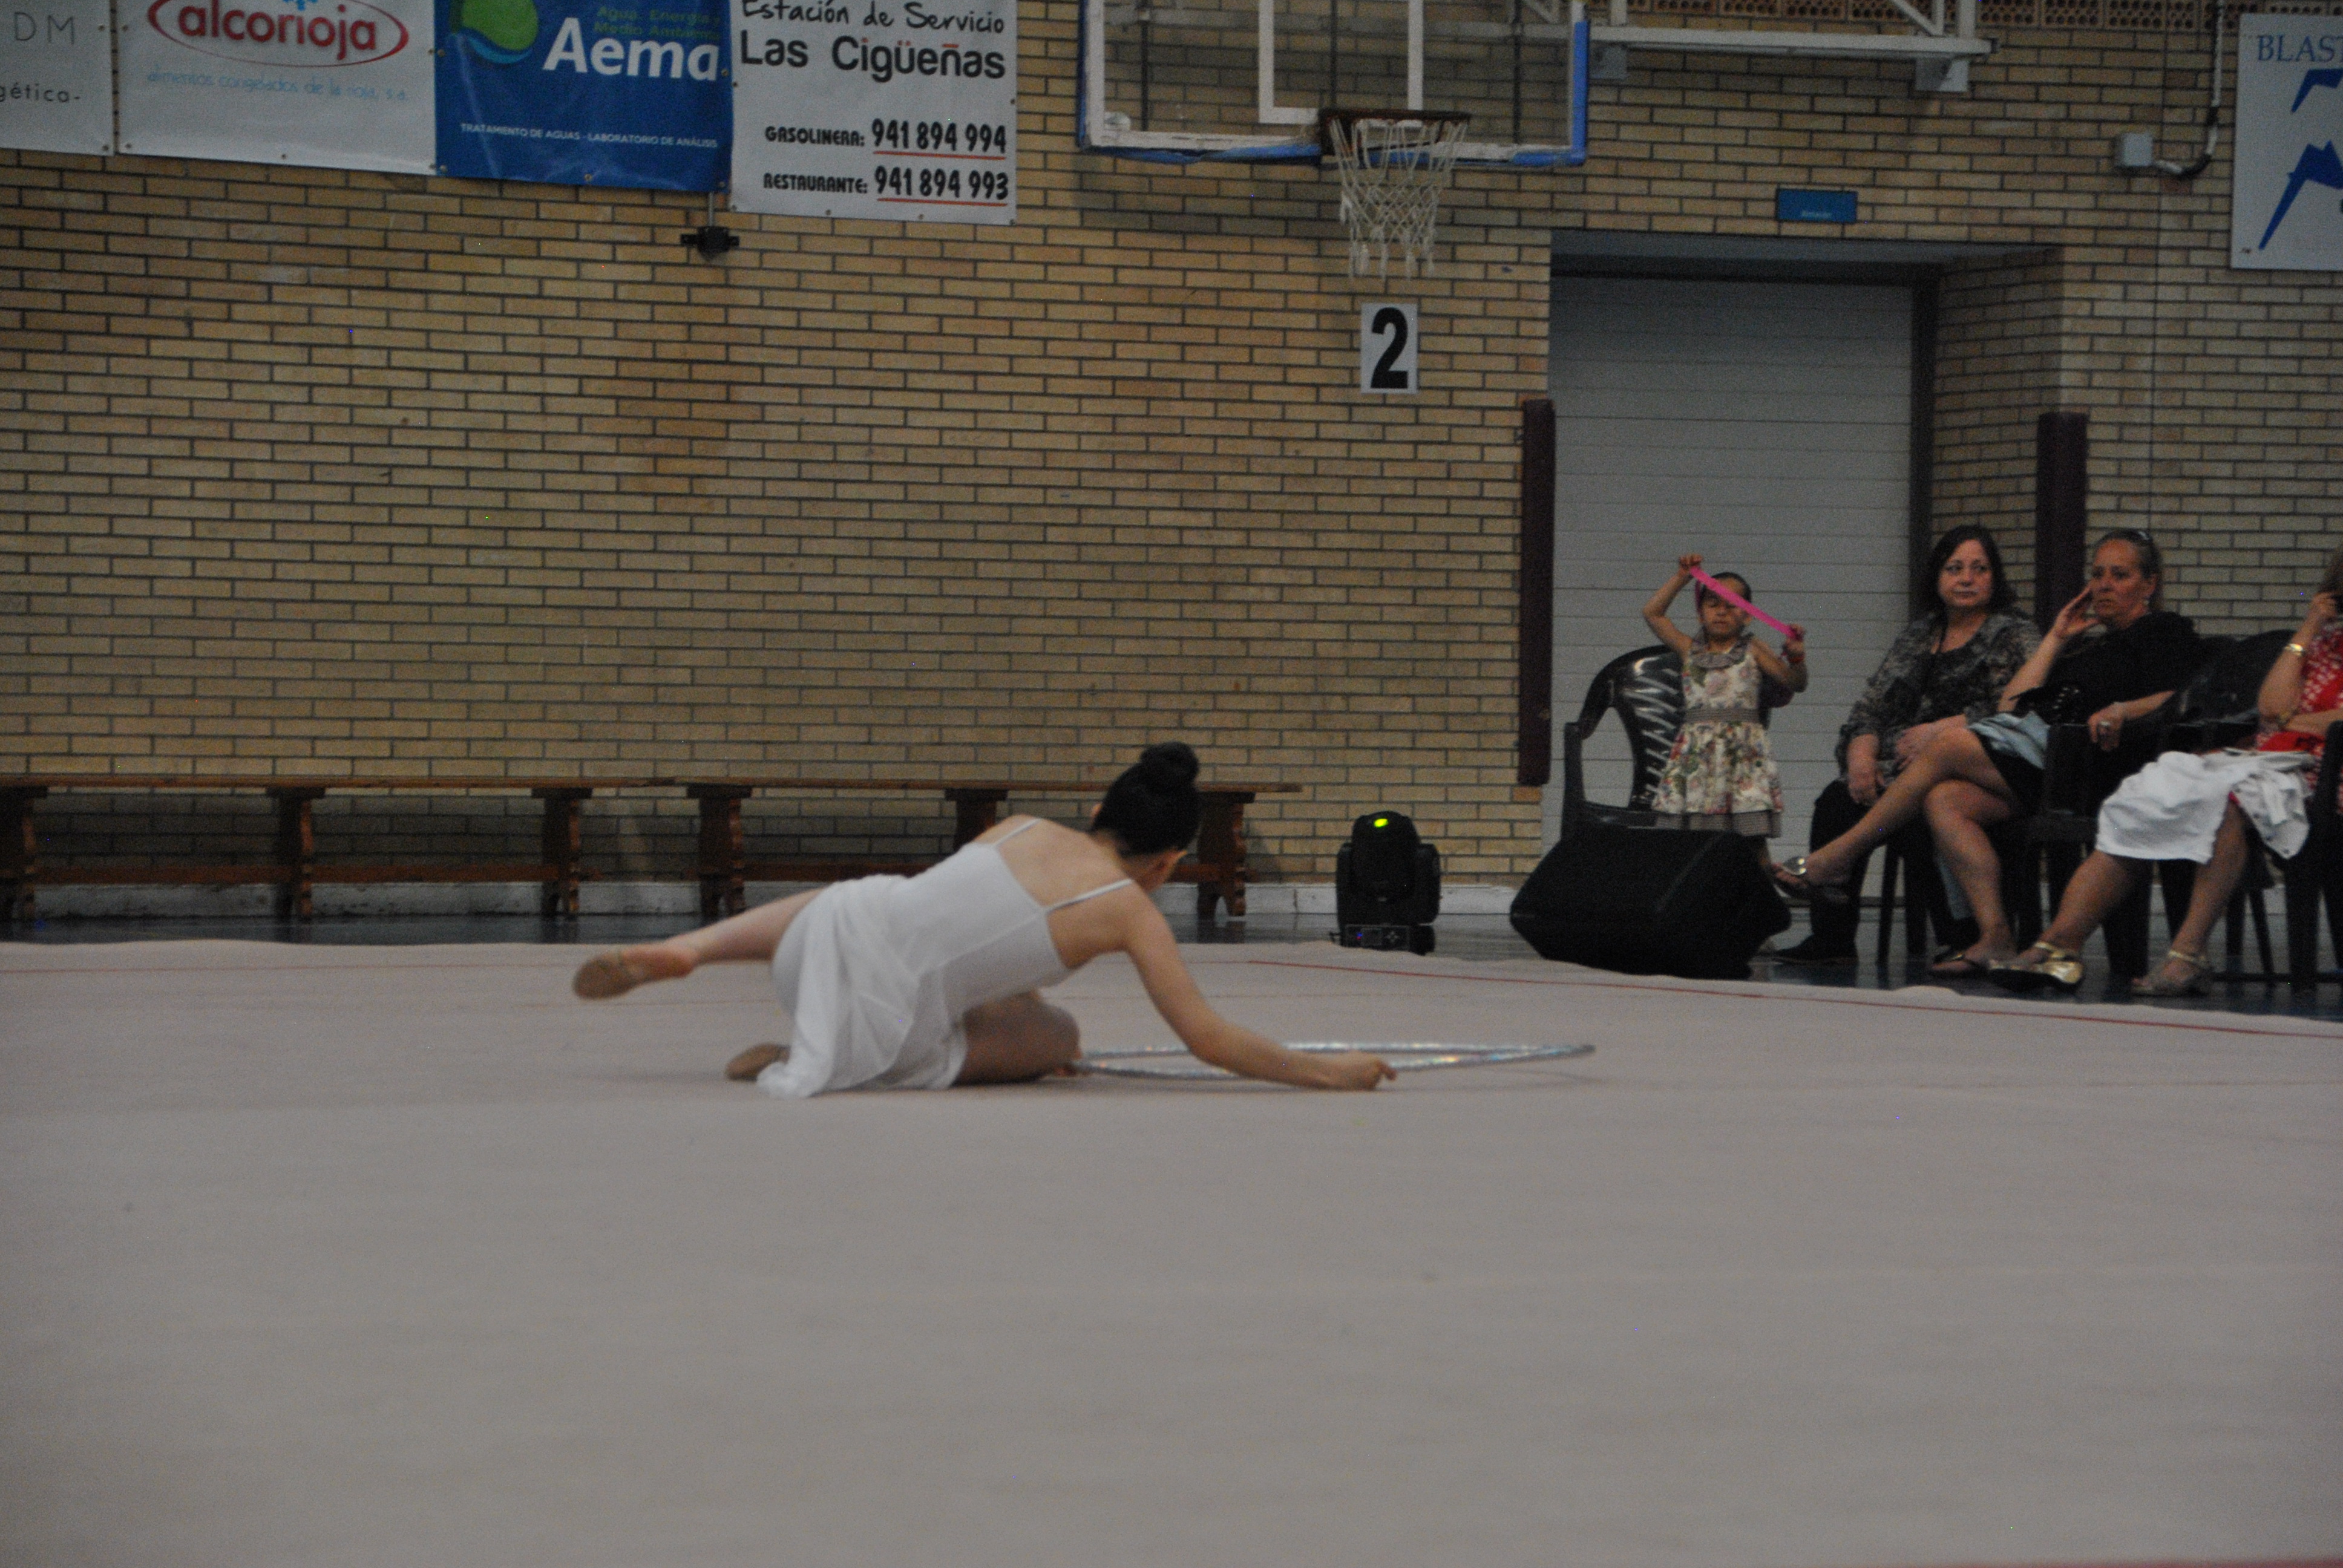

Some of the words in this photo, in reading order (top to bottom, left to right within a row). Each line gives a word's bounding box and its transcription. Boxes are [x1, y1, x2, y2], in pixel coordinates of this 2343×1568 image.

[178, 0, 376, 60] alcorioja
[742, 0, 848, 24] Estación
[863, 1, 894, 27] de
[904, 2, 1004, 34] Servicio
[542, 17, 719, 81] Aema
[740, 29, 808, 68] Las
[831, 36, 1006, 82] Cigüeñas
[460, 123, 528, 137] TRATAMIENTO
[529, 128, 542, 138] DE
[545, 129, 580, 140] AGUAS
[588, 132, 659, 145] LABORATORIO
[661, 136, 673, 146] DE
[765, 125, 865, 146] GASOLINERA:
[872, 119, 909, 149] 941
[917, 121, 957, 151] 894
[965, 123, 1006, 154] 994
[764, 172, 868, 194] RESTAURANTE:
[874, 165, 912, 195] 941
[920, 168, 960, 198] 894
[969, 170, 1009, 200] 993
[1371, 307, 1407, 388] 2
